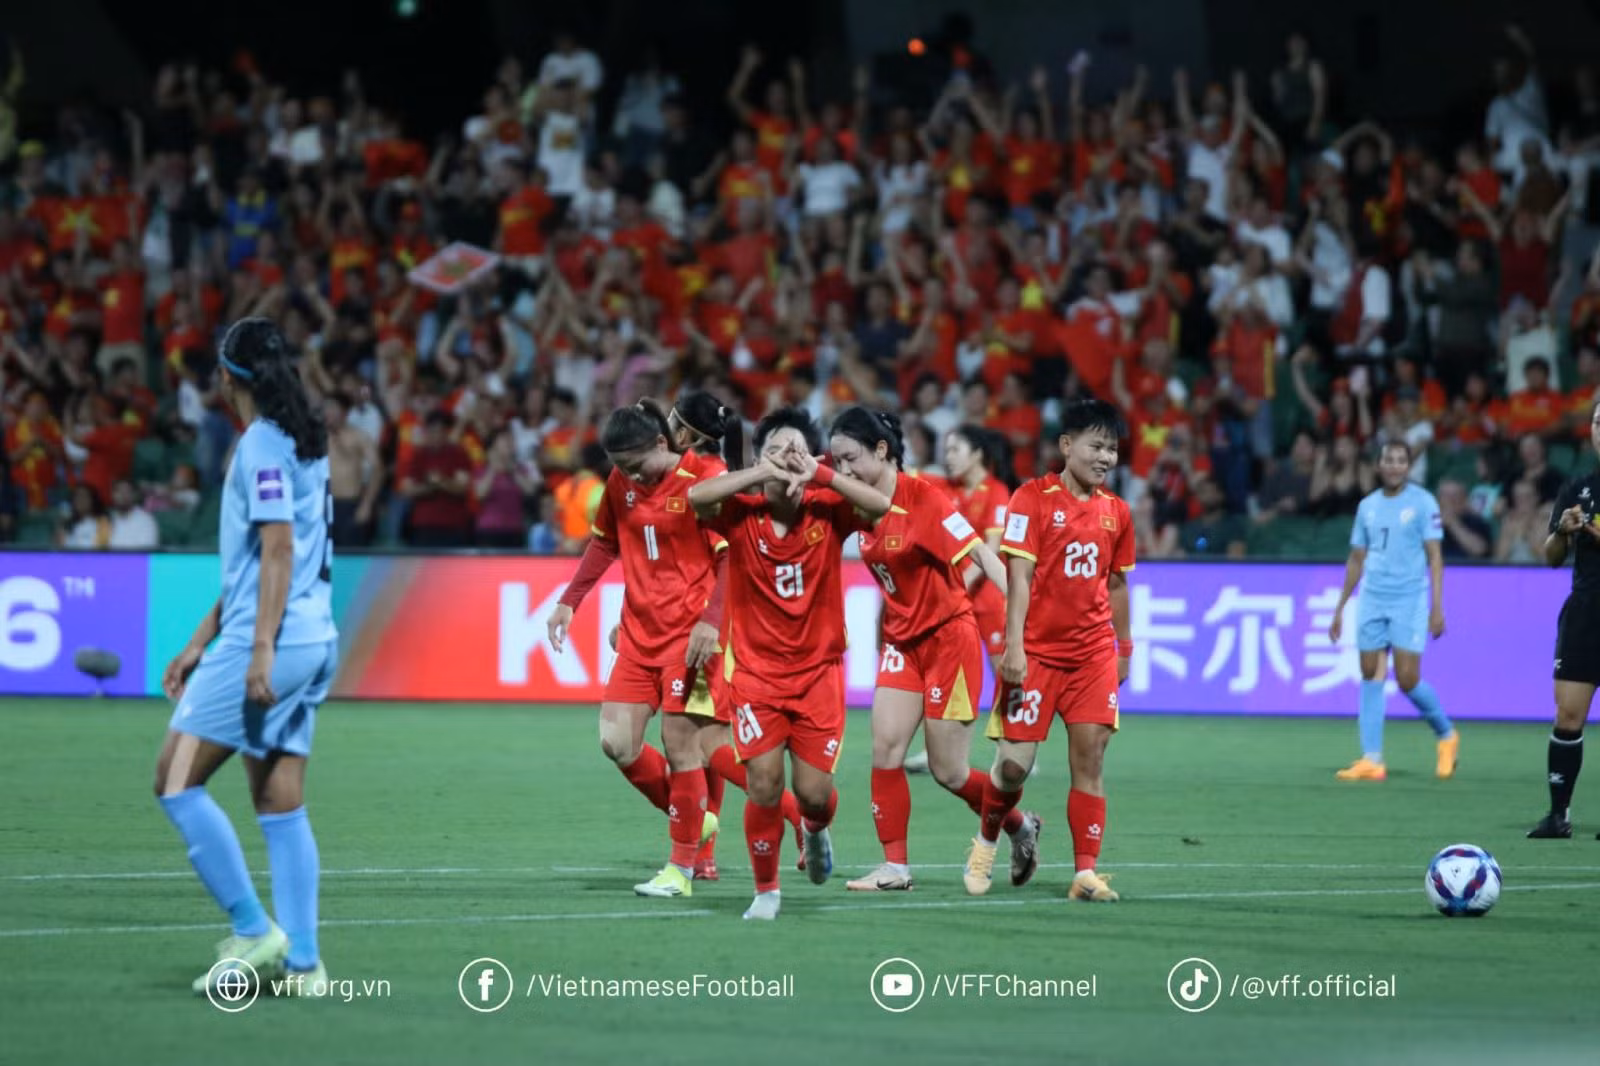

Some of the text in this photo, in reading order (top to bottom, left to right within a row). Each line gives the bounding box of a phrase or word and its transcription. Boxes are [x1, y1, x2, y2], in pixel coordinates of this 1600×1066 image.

[644, 525, 660, 561] 11
[1380, 527, 1389, 551] 7
[1064, 541, 1099, 579] 23
[775, 563, 804, 598] 21
[736, 703, 763, 745] 21
[1006, 688, 1042, 726] 23
